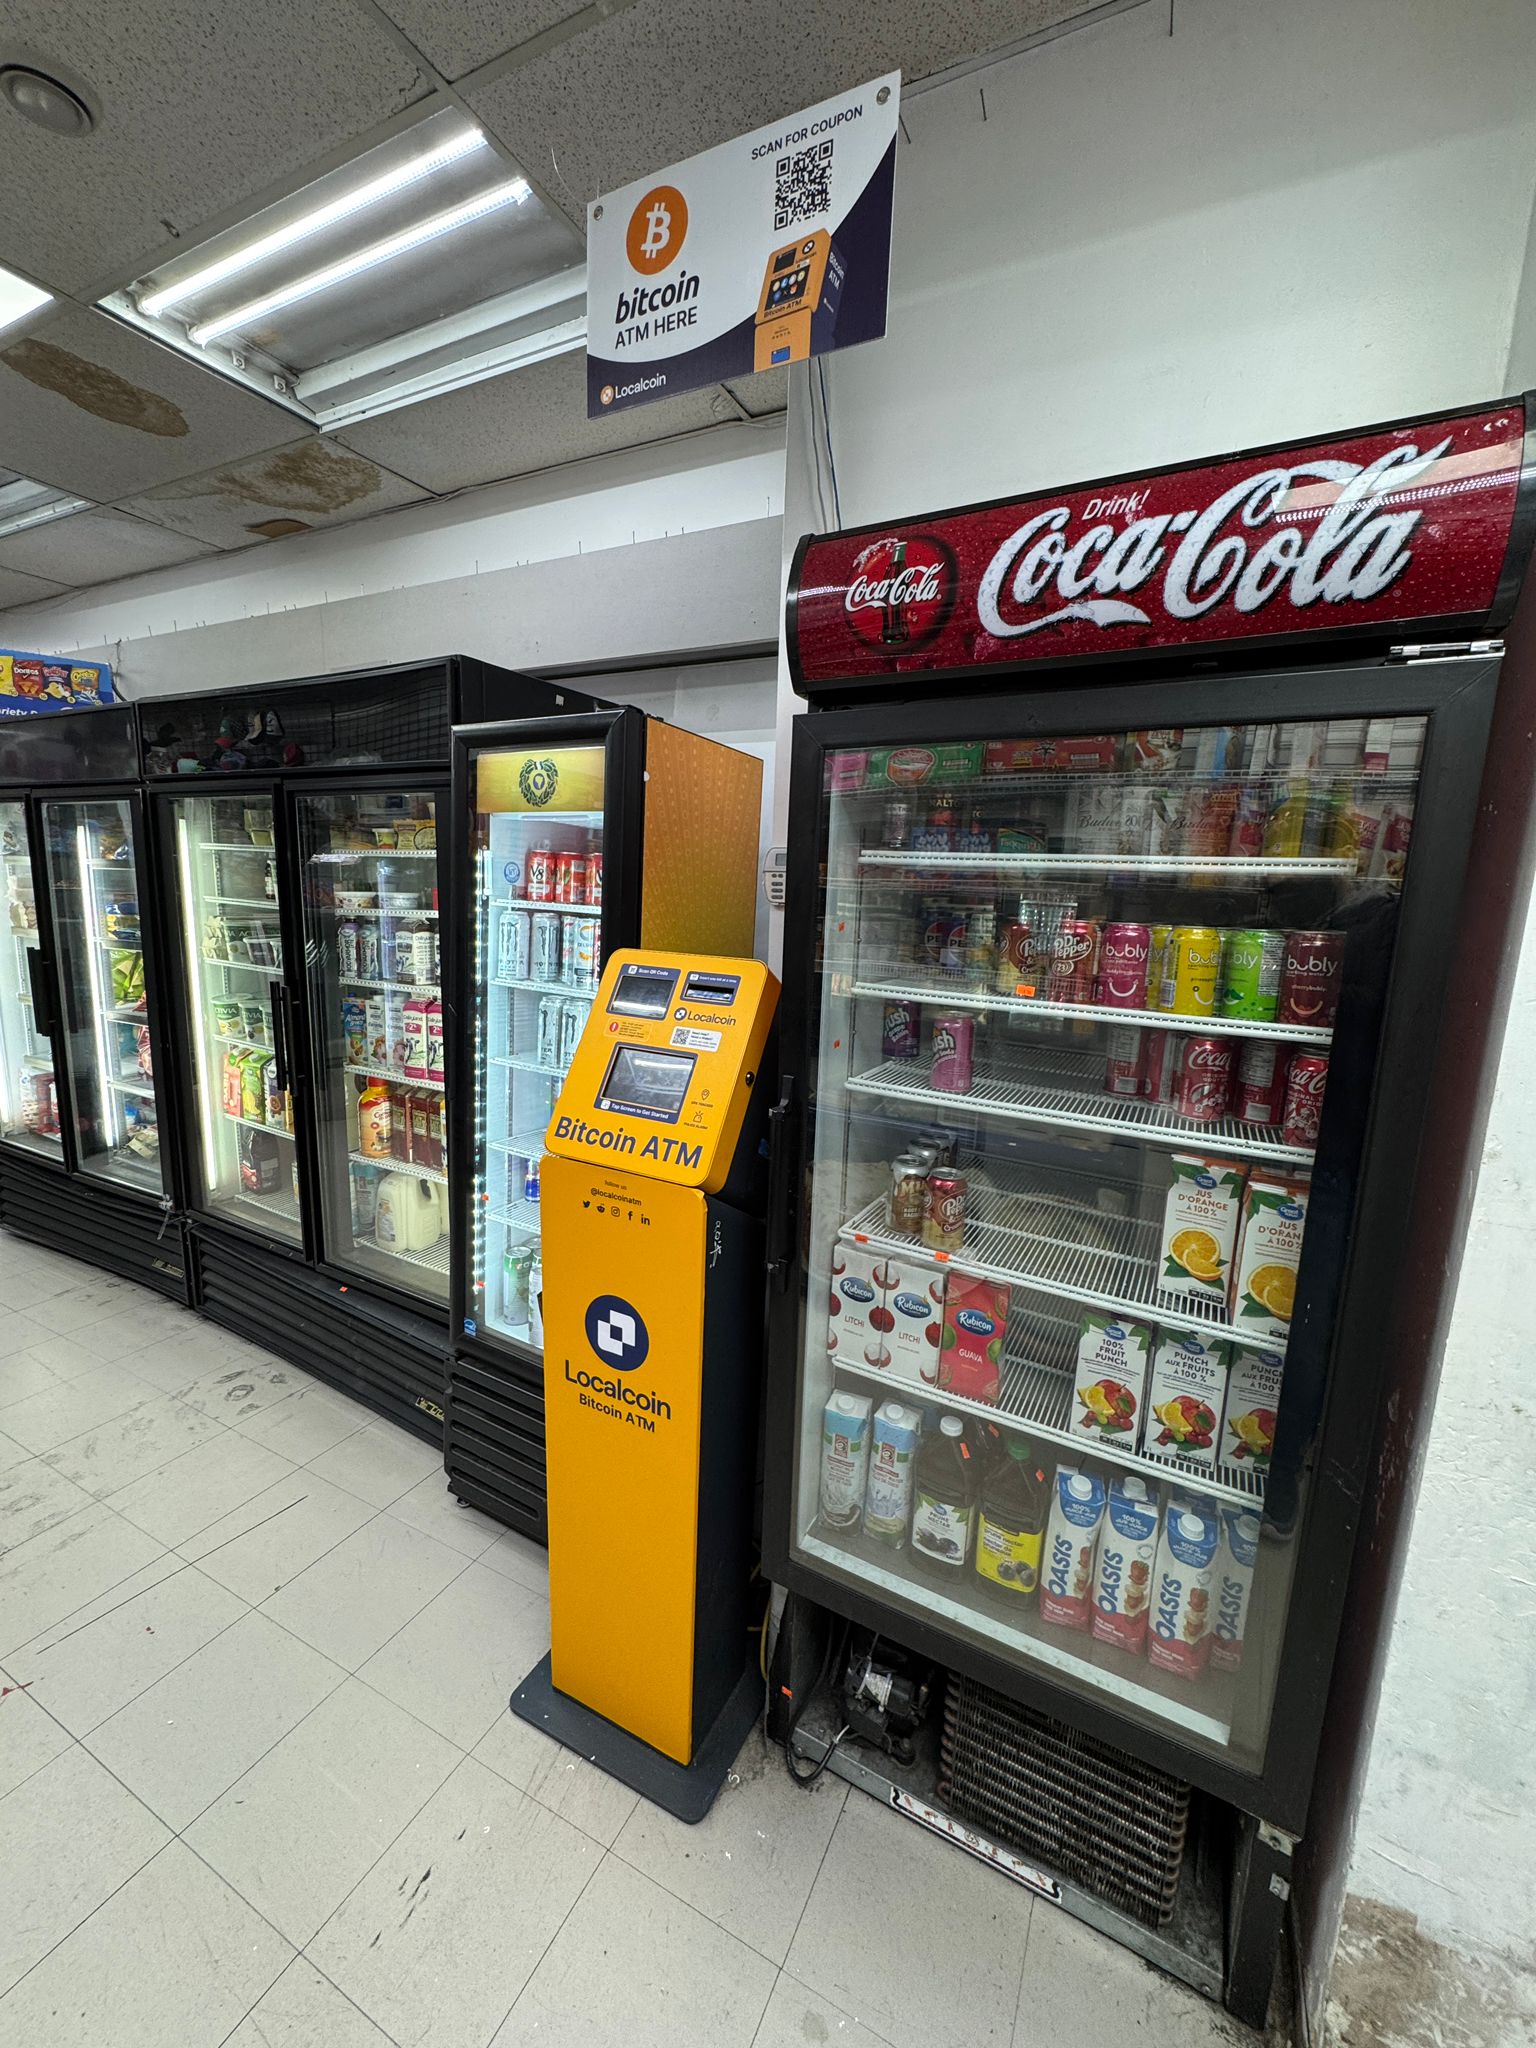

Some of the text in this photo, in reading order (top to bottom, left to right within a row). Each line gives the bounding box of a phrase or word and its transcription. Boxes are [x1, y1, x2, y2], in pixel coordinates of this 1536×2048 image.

[751, 104, 864, 160] SCAN FOR COUPON
[614, 270, 700, 325] bitcoin
[614, 305, 698, 350] ATM HERE
[614, 372, 667, 400] Localcoin
[1081, 487, 1150, 522] Drink!
[977, 436, 1454, 637] Coca-Cola
[843, 562, 944, 613] Coca-Cola
[530, 863, 546, 881] V8
[1053, 938, 1090, 960] Pepper
[1063, 935, 1081, 947] Dr
[1105, 943, 1148, 962] bubly
[1286, 954, 1338, 977] bubly
[687, 1008, 737, 1027] Localcoin
[611, 1102, 621, 1112] Tap
[621, 1104, 637, 1114] Screen
[640, 1107, 651, 1116] Get
[650, 1110, 669, 1120] Started
[554, 1116, 703, 1169] Bitcoin ATM
[1177, 1193, 1229, 1212] D'ORANGE
[1195, 1189, 1213, 1199] JUS
[1257, 1224, 1301, 1241] D'ORAN
[1278, 1220, 1298, 1231] JUS
[842, 1281, 873, 1299] Rubicon
[895, 1297, 930, 1314] Rubicon
[844, 1315, 866, 1328] LITCHI
[958, 1311, 993, 1331] Rubicon
[897, 1331, 921, 1345] LITCHI
[1101, 1338, 1125, 1351] 100%
[957, 1347, 984, 1365] GUAVA
[1094, 1352, 1129, 1368] PUNCH
[1098, 1345, 1127, 1360] FRUIT
[1174, 1351, 1209, 1367] PUNCH
[1164, 1358, 1217, 1378] AUX FRUITS
[1240, 1371, 1280, 1386] AUX FRU
[564, 1359, 672, 1421] Localcoin
[579, 1392, 656, 1433] Bitcoin ATM
[929, 1511, 950, 1523] PRUNE
[1071, 1502, 1091, 1514] 100%
[927, 1515, 951, 1529] NECTAR
[1121, 1513, 1143, 1527] 100%
[1048, 1534, 1073, 1597] OASIS
[1097, 1548, 1124, 1616] OASIS
[1155, 1573, 1182, 1642] OASIS
[1215, 1576, 1244, 1641] OASIS
